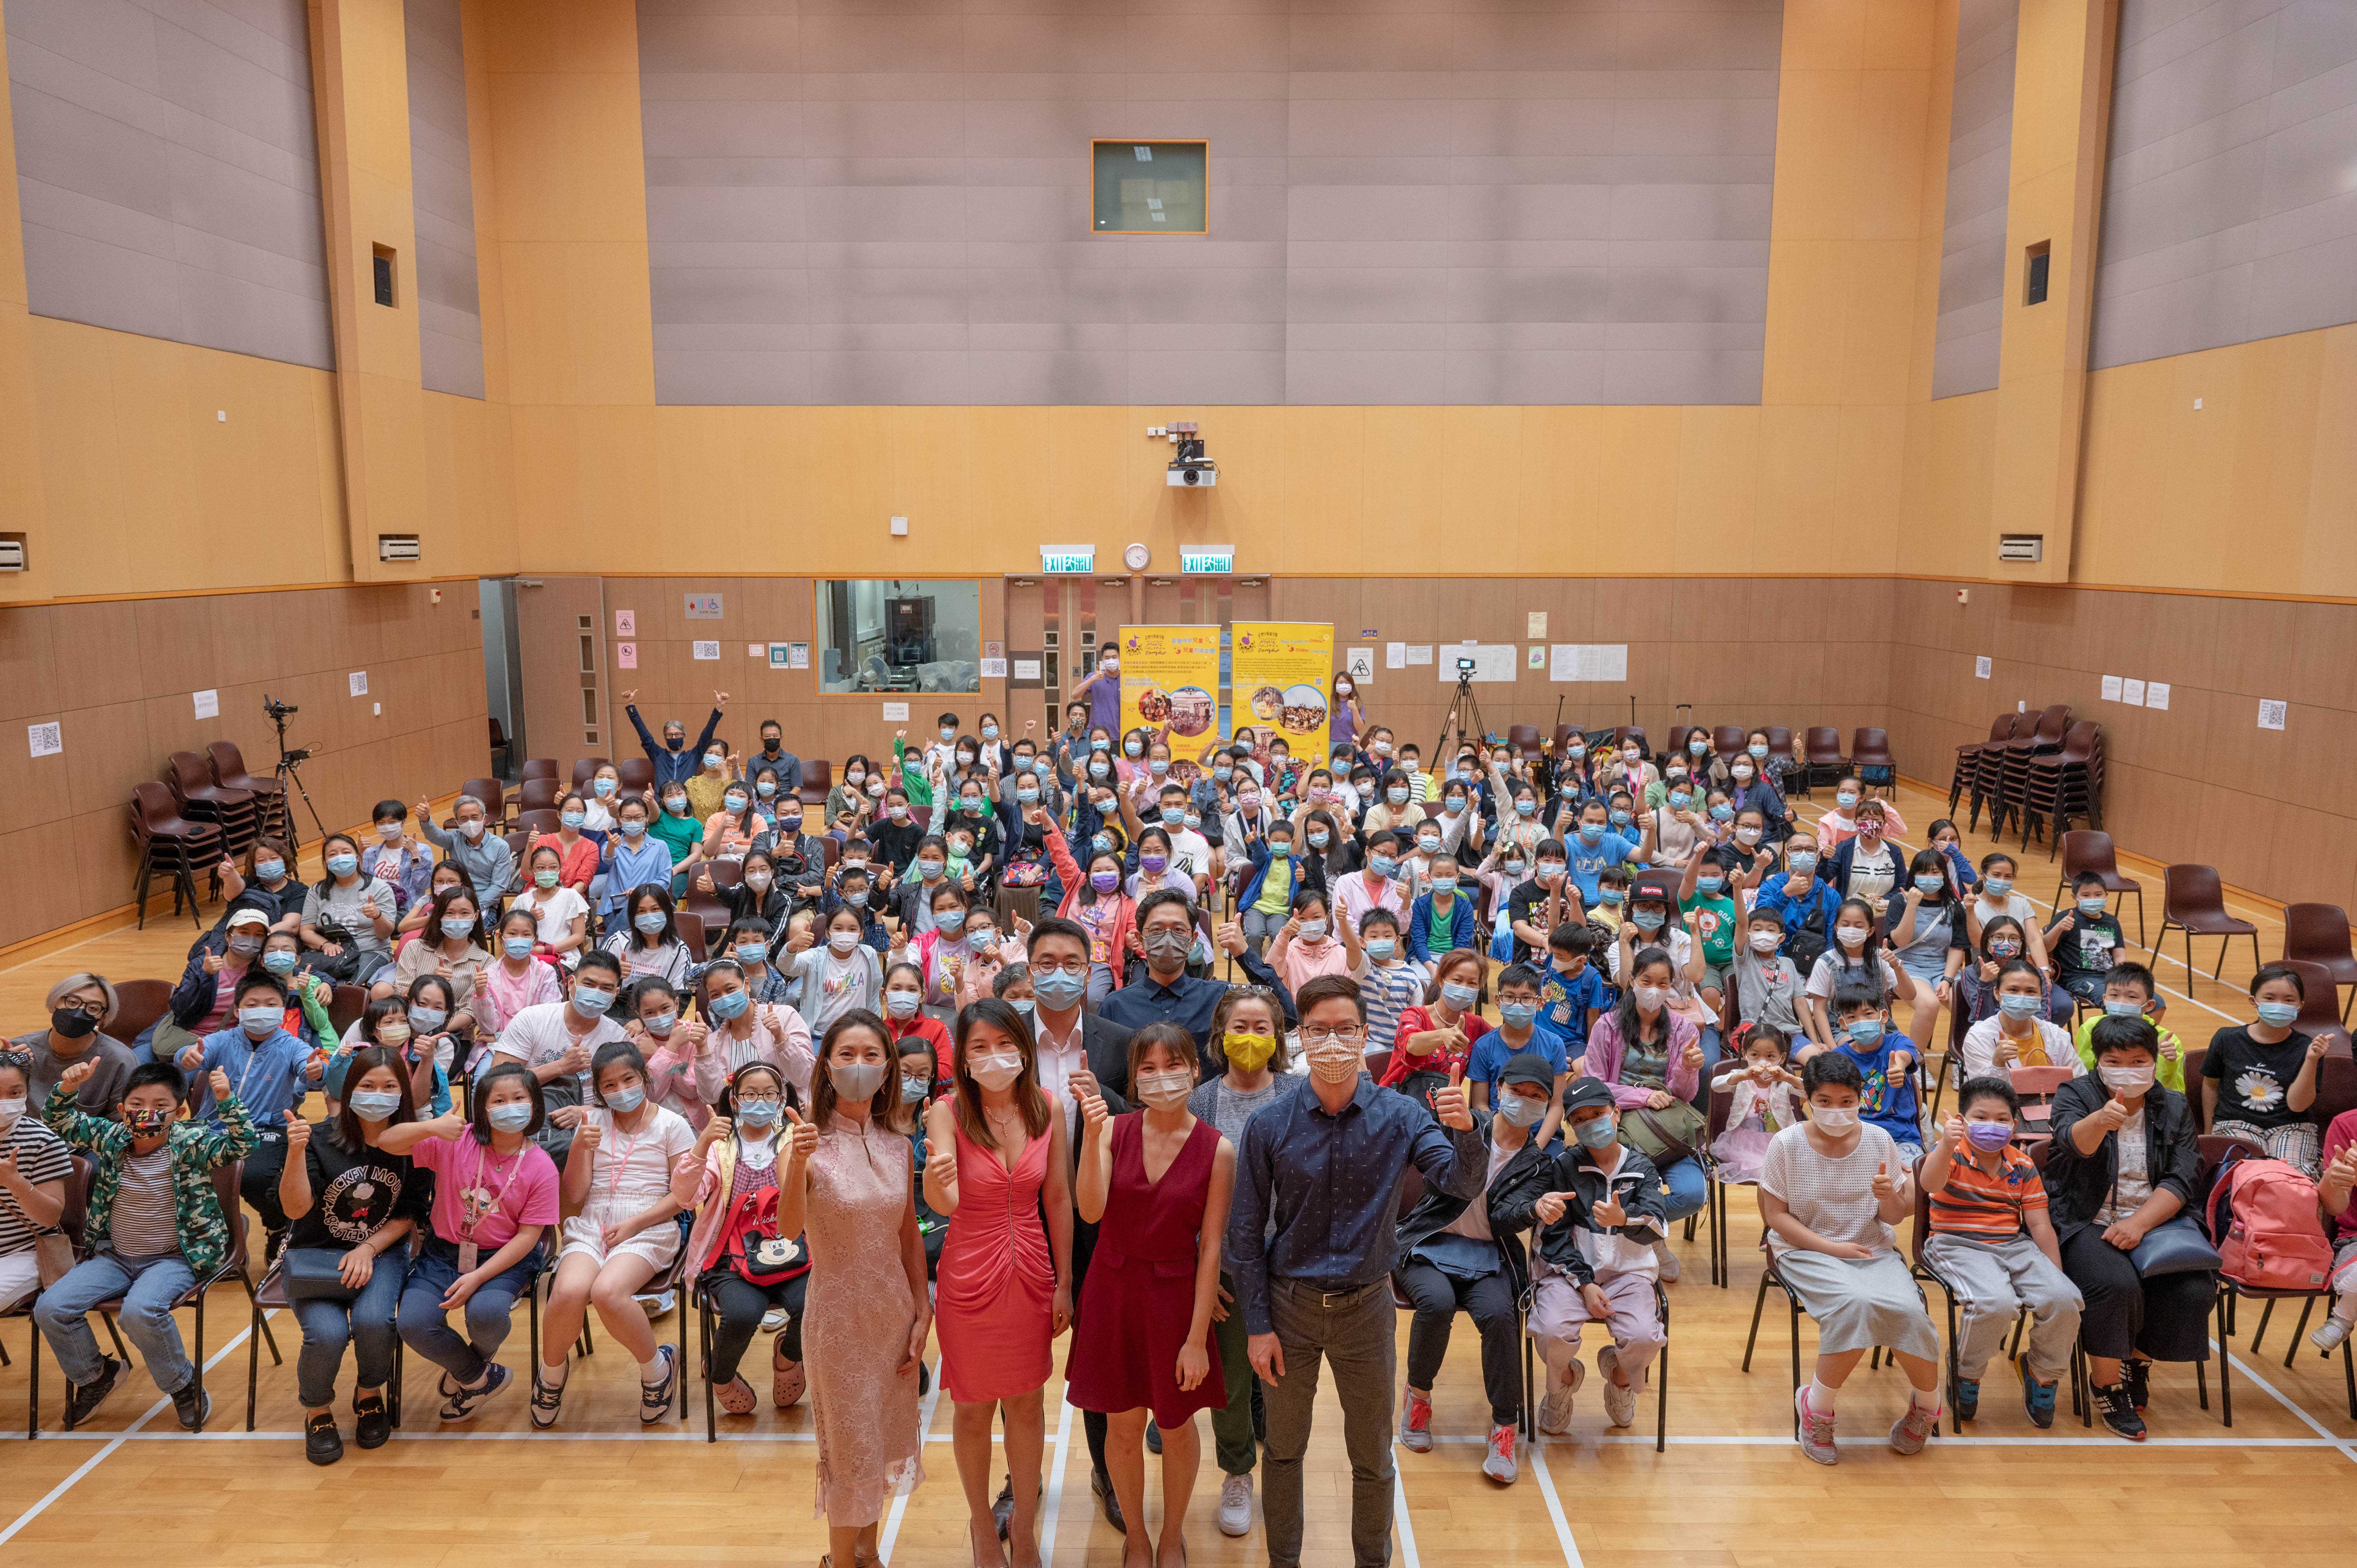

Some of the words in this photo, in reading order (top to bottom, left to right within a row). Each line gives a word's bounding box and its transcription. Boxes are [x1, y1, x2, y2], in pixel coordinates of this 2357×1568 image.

[1044, 556, 1064, 571] EXIT
[1075, 556, 1091, 571] 出口
[1184, 556, 1203, 571] EXIT
[1215, 556, 1230, 571] 出口
[1717, 910, 1733, 927] GOAL
[323, 1165, 369, 1205] MICKEY
